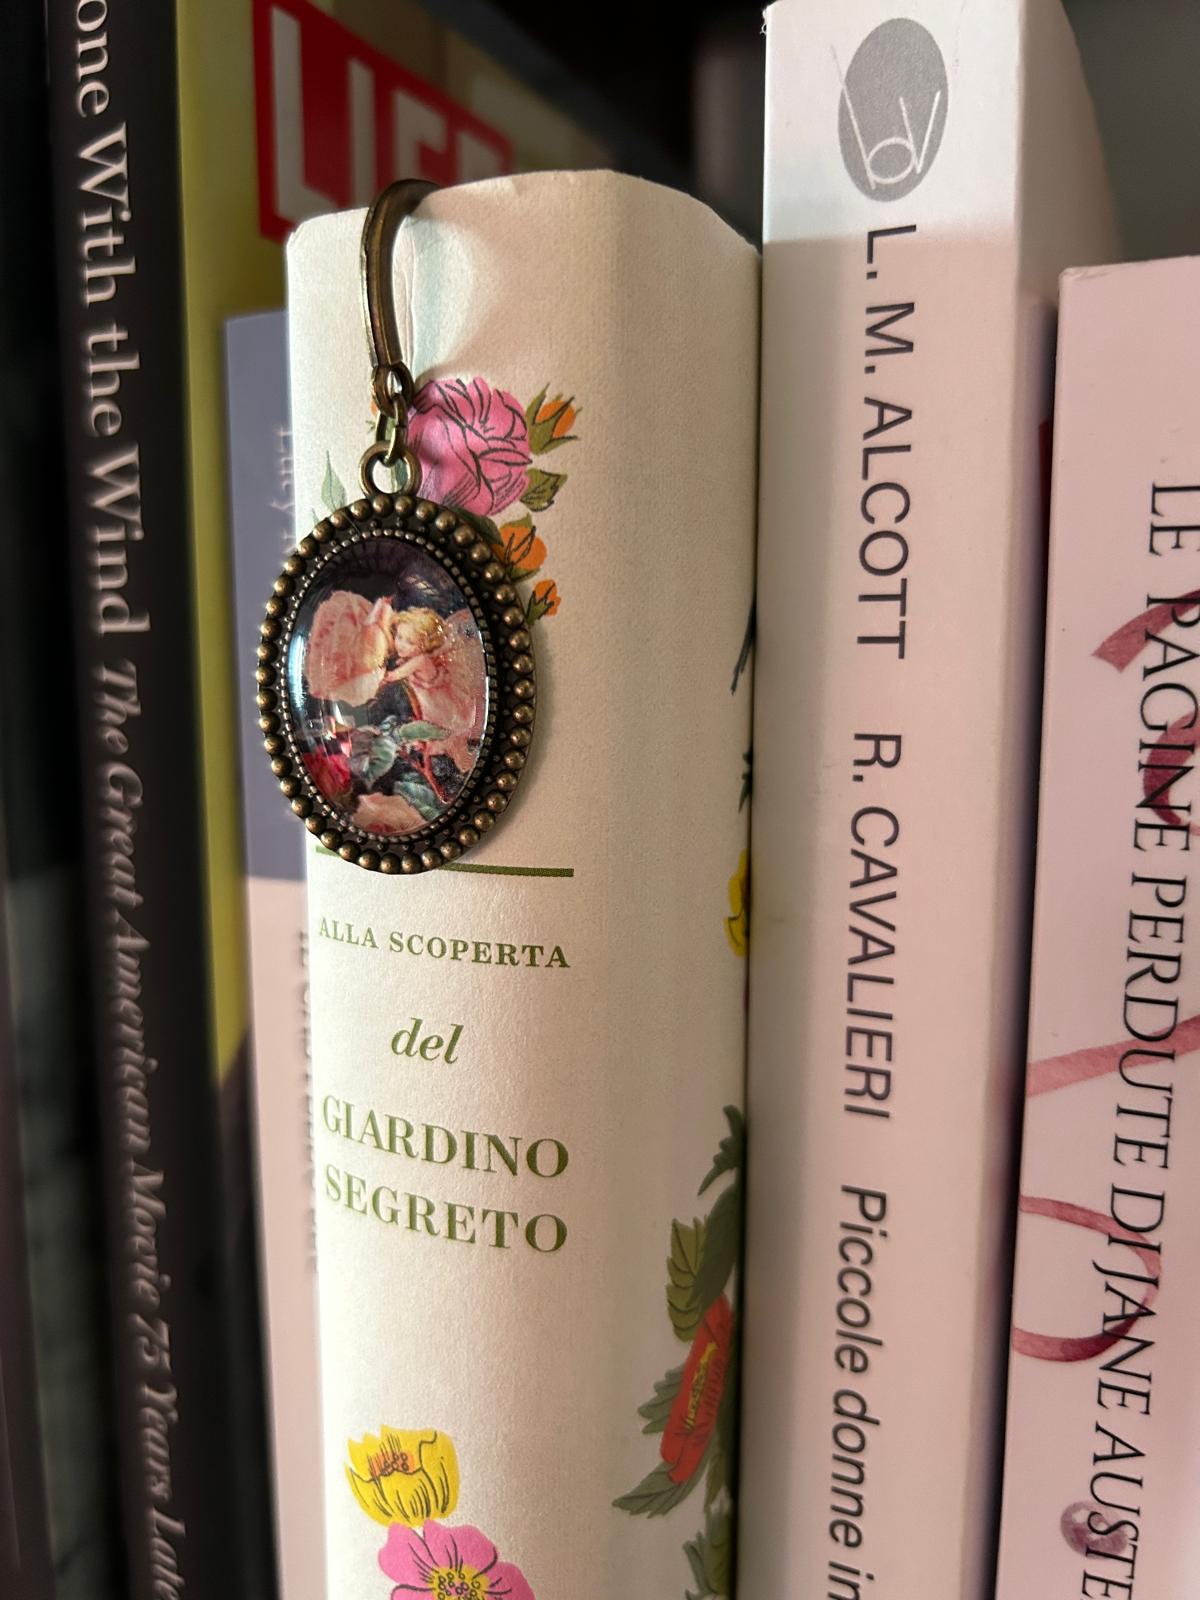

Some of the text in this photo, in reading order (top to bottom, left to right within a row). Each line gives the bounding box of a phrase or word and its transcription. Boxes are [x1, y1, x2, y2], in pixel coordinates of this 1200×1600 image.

[78, 121, 137, 307] With
[866, 224, 917, 281] L.
[83, 322, 140, 437] the
[864, 301, 915, 375] M.
[88, 443, 152, 636] Wind
[856, 396, 914, 660] ALCOTT
[1148, 481, 1200, 557] LE
[95, 657, 142, 755] The
[852, 732, 903, 783] R.
[1132, 593, 1200, 852] PAGINE
[102, 761, 144, 908] Great
[318, 915, 571, 969] ALLA SCOPERTA
[843, 806, 900, 1120] CAVALIERI
[111, 908, 158, 1153] American
[390, 1016, 465, 1065] del
[1113, 871, 1187, 1170] PERDUTE
[321, 1093, 570, 1179] GIARDINO
[124, 1157, 171, 1308] Movie
[324, 1163, 569, 1254] SEGRETO
[1107, 1183, 1166, 1255] DI
[834, 1184, 889, 1376] Piccole
[1092, 1259, 1160, 1416] JANE
[130, 1312, 172, 1374] 75
[138, 1382, 179, 1502] Years
[828, 1388, 882, 1550] donne
